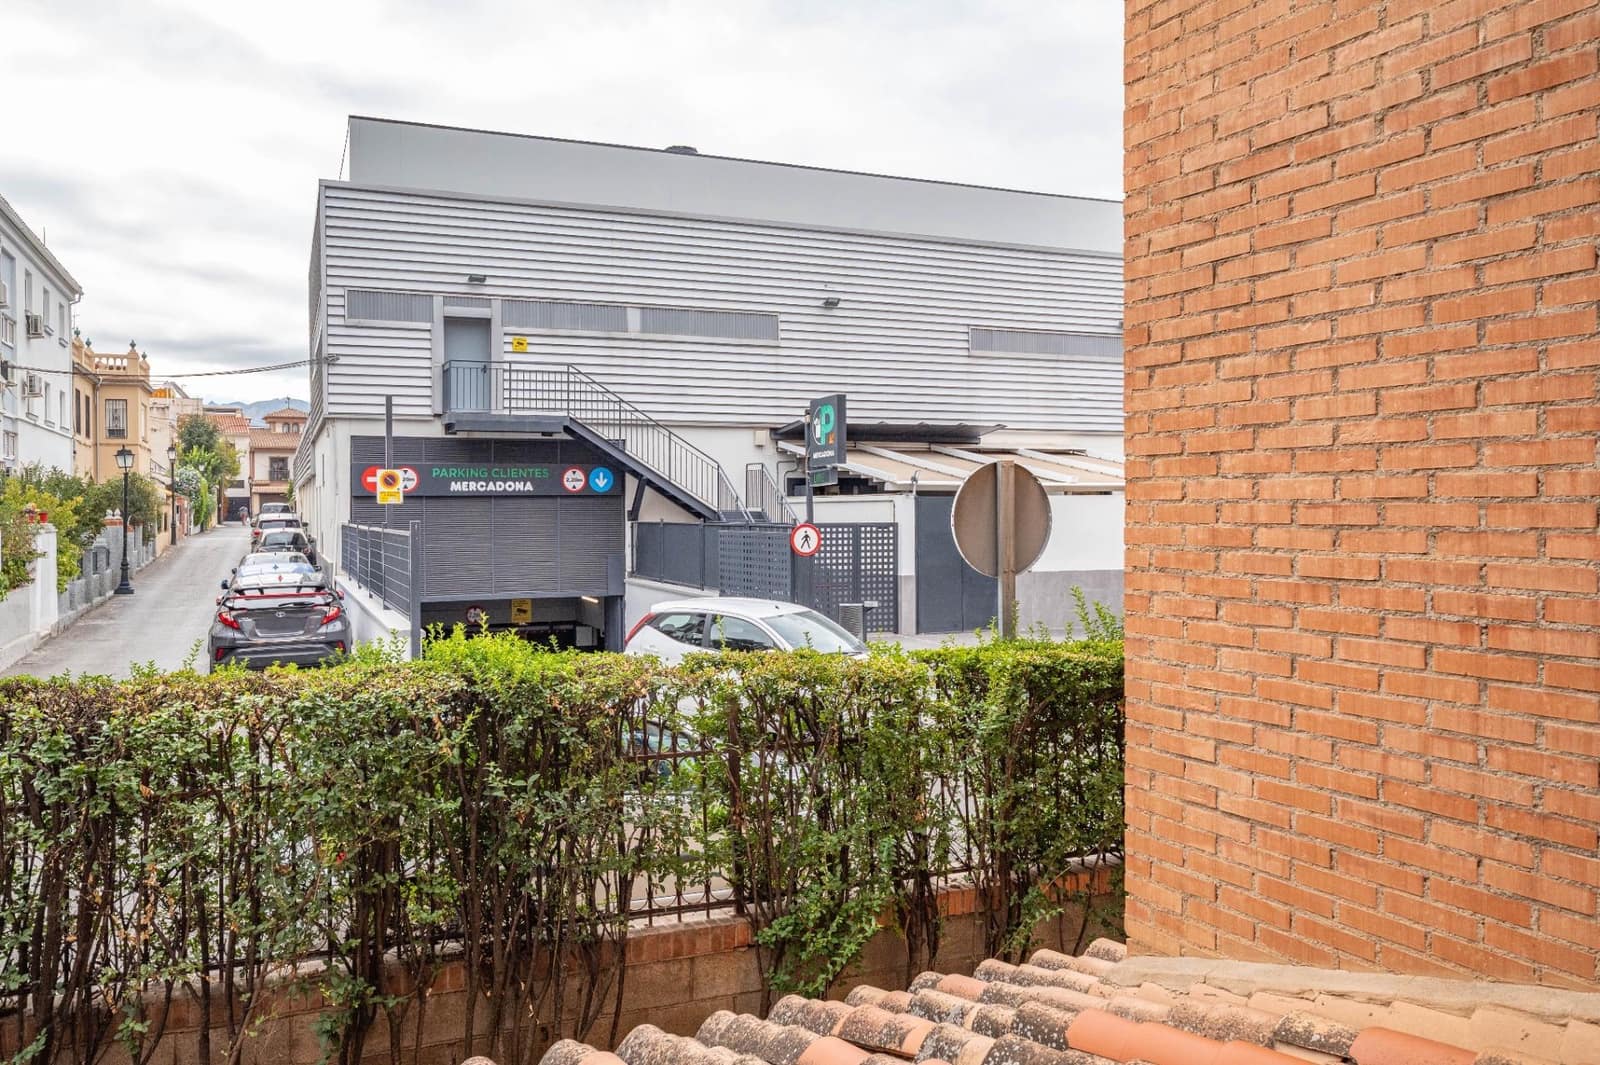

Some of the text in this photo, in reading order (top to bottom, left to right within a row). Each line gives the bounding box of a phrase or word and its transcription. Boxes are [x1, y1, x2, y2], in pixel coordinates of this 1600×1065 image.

[432, 468, 549, 478] PARKING CLIENTES
[450, 481, 534, 492] MERCADONA
